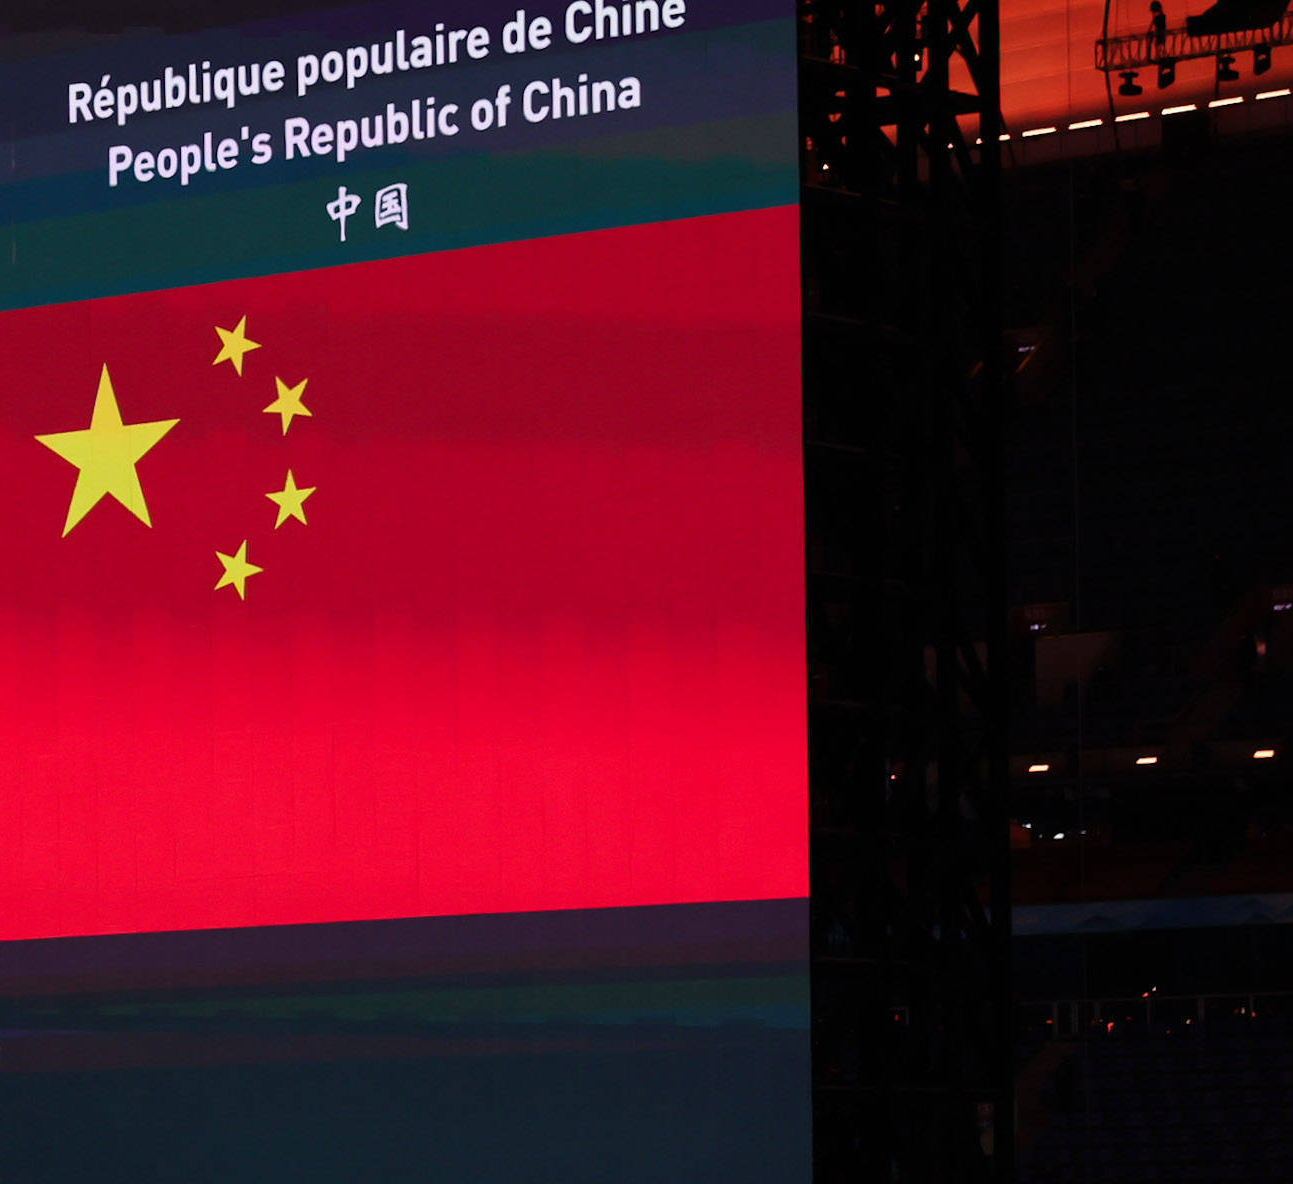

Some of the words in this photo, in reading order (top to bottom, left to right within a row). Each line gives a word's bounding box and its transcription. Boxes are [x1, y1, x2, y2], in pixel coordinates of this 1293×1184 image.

[68, 61, 285, 125] République
[297, 23, 490, 97] populaire
[502, 10, 552, 54] de
[565, 0, 686, 44] Chine
[108, 127, 273, 187] People's
[284, 96, 459, 163] Republic
[471, 85, 511, 131] of
[523, 74, 641, 123] China
[326, 183, 409, 242] 中国
